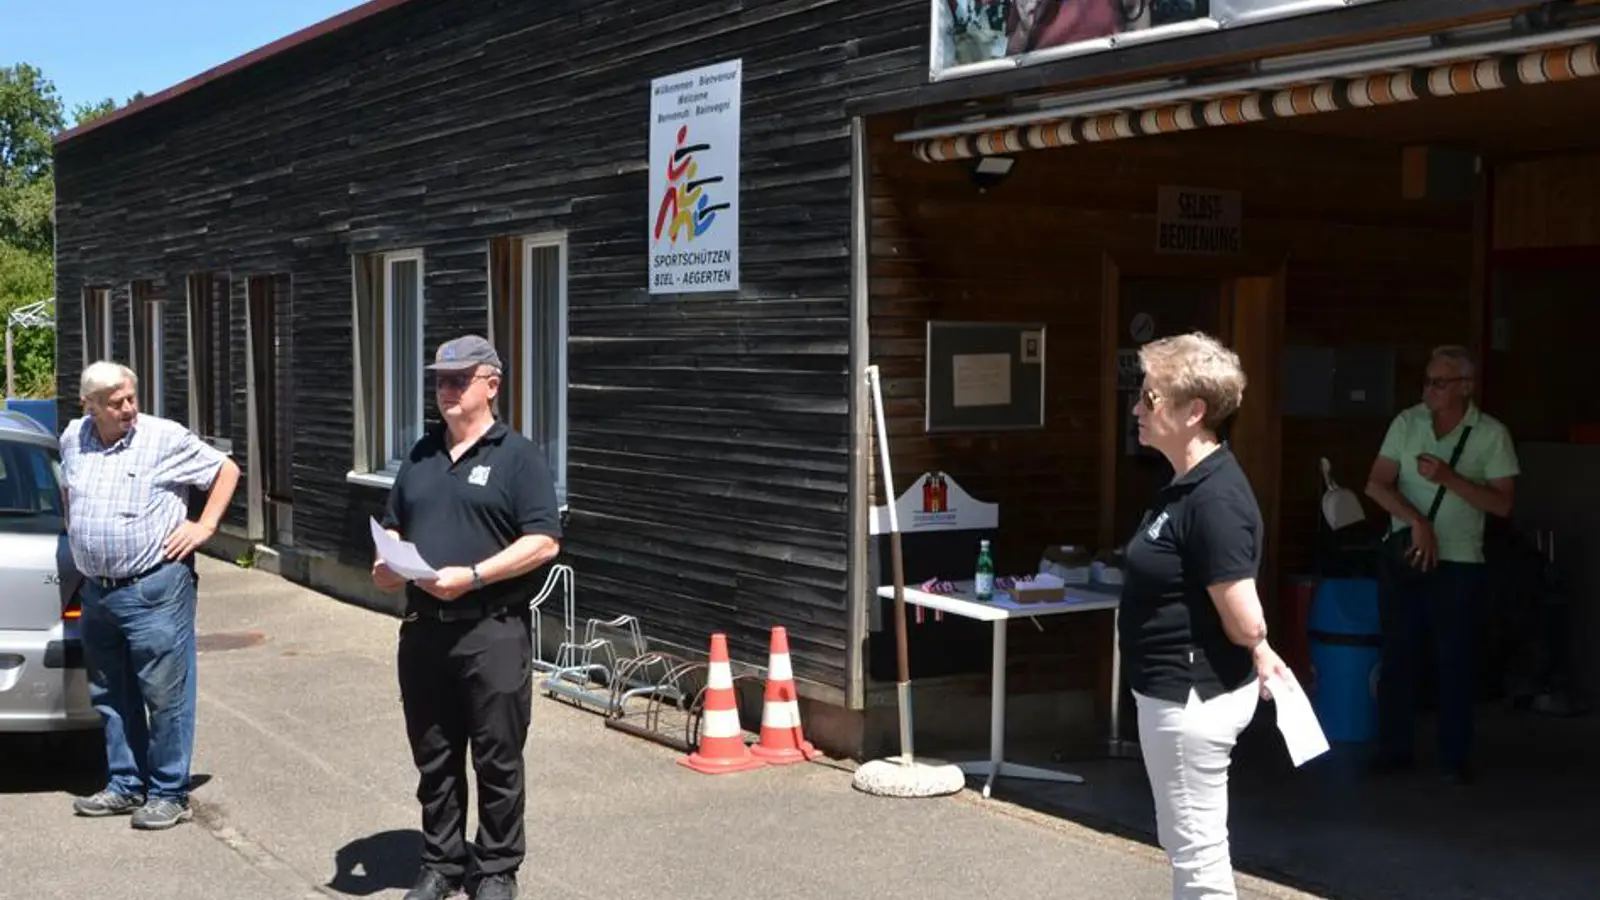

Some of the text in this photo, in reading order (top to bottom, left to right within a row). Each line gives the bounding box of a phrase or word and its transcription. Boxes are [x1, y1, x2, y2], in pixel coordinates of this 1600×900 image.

[678, 92, 708, 104] Welcome
[1159, 222, 1239, 251] BEDIENUNG
[654, 249, 731, 268] SPORTSCHÜTZEN
[654, 272, 674, 286] BIEL
[682, 269, 731, 286] AEGERTEN
